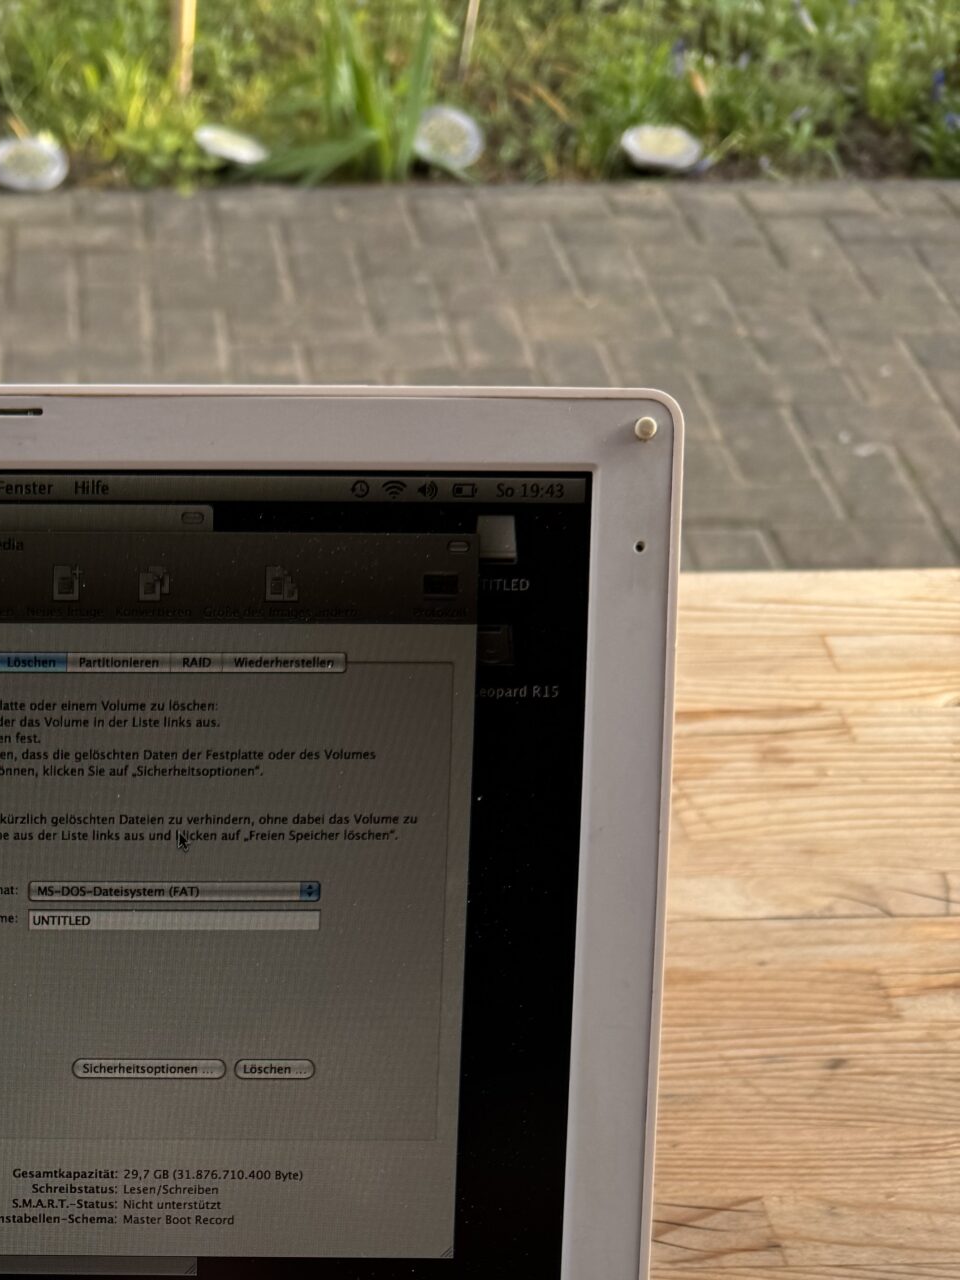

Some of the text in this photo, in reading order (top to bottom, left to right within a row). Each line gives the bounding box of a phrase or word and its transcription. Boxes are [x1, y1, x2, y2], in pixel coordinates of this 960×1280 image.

[73, 480, 110, 495] Hilfe
[495, 482, 565, 499] So 19:43
[6, 655, 57, 668] Löschen
[78, 656, 160, 669] Partitionieren
[182, 657, 212, 668] RAID
[233, 657, 334, 669] Wiederherstellen
[477, 685, 560, 700] eopard R15
[30, 700, 57, 711] oder
[61, 700, 97, 711] einem
[101, 701, 146, 712] Volume
[150, 702, 164, 712] zu
[168, 700, 218, 712] löschen:
[19, 716, 40, 727] das
[44, 717, 89, 728] Volume
[93, 717, 105, 728] in
[108, 717, 129, 728] der
[132, 717, 160, 728] Liste
[163, 717, 192, 728] links
[195, 718, 221, 728] aus.
[15, 732, 41, 744] fest.
[36, 884, 165, 900] MS-DOS-Dateisystem
[168, 884, 201, 899] (FAT)
[32, 914, 91, 927] UNTITLED
[82, 1062, 198, 1078] Sicherheitsoptionen
[243, 1062, 292, 1076] Löschen
[12, 1167, 304, 1182] Gesamtkapazität: 29,7 GB (31.876.710.400 Byte)
[31, 1183, 219, 1196] Schreibstatus: Lesen/Schreiben
[11, 1198, 222, 1210] S.M.A.R.T.-Status: Nicht unterstützt
[123, 1214, 161, 1225] Master
[165, 1215, 191, 1225] Boot
[195, 1215, 234, 1225] Record
